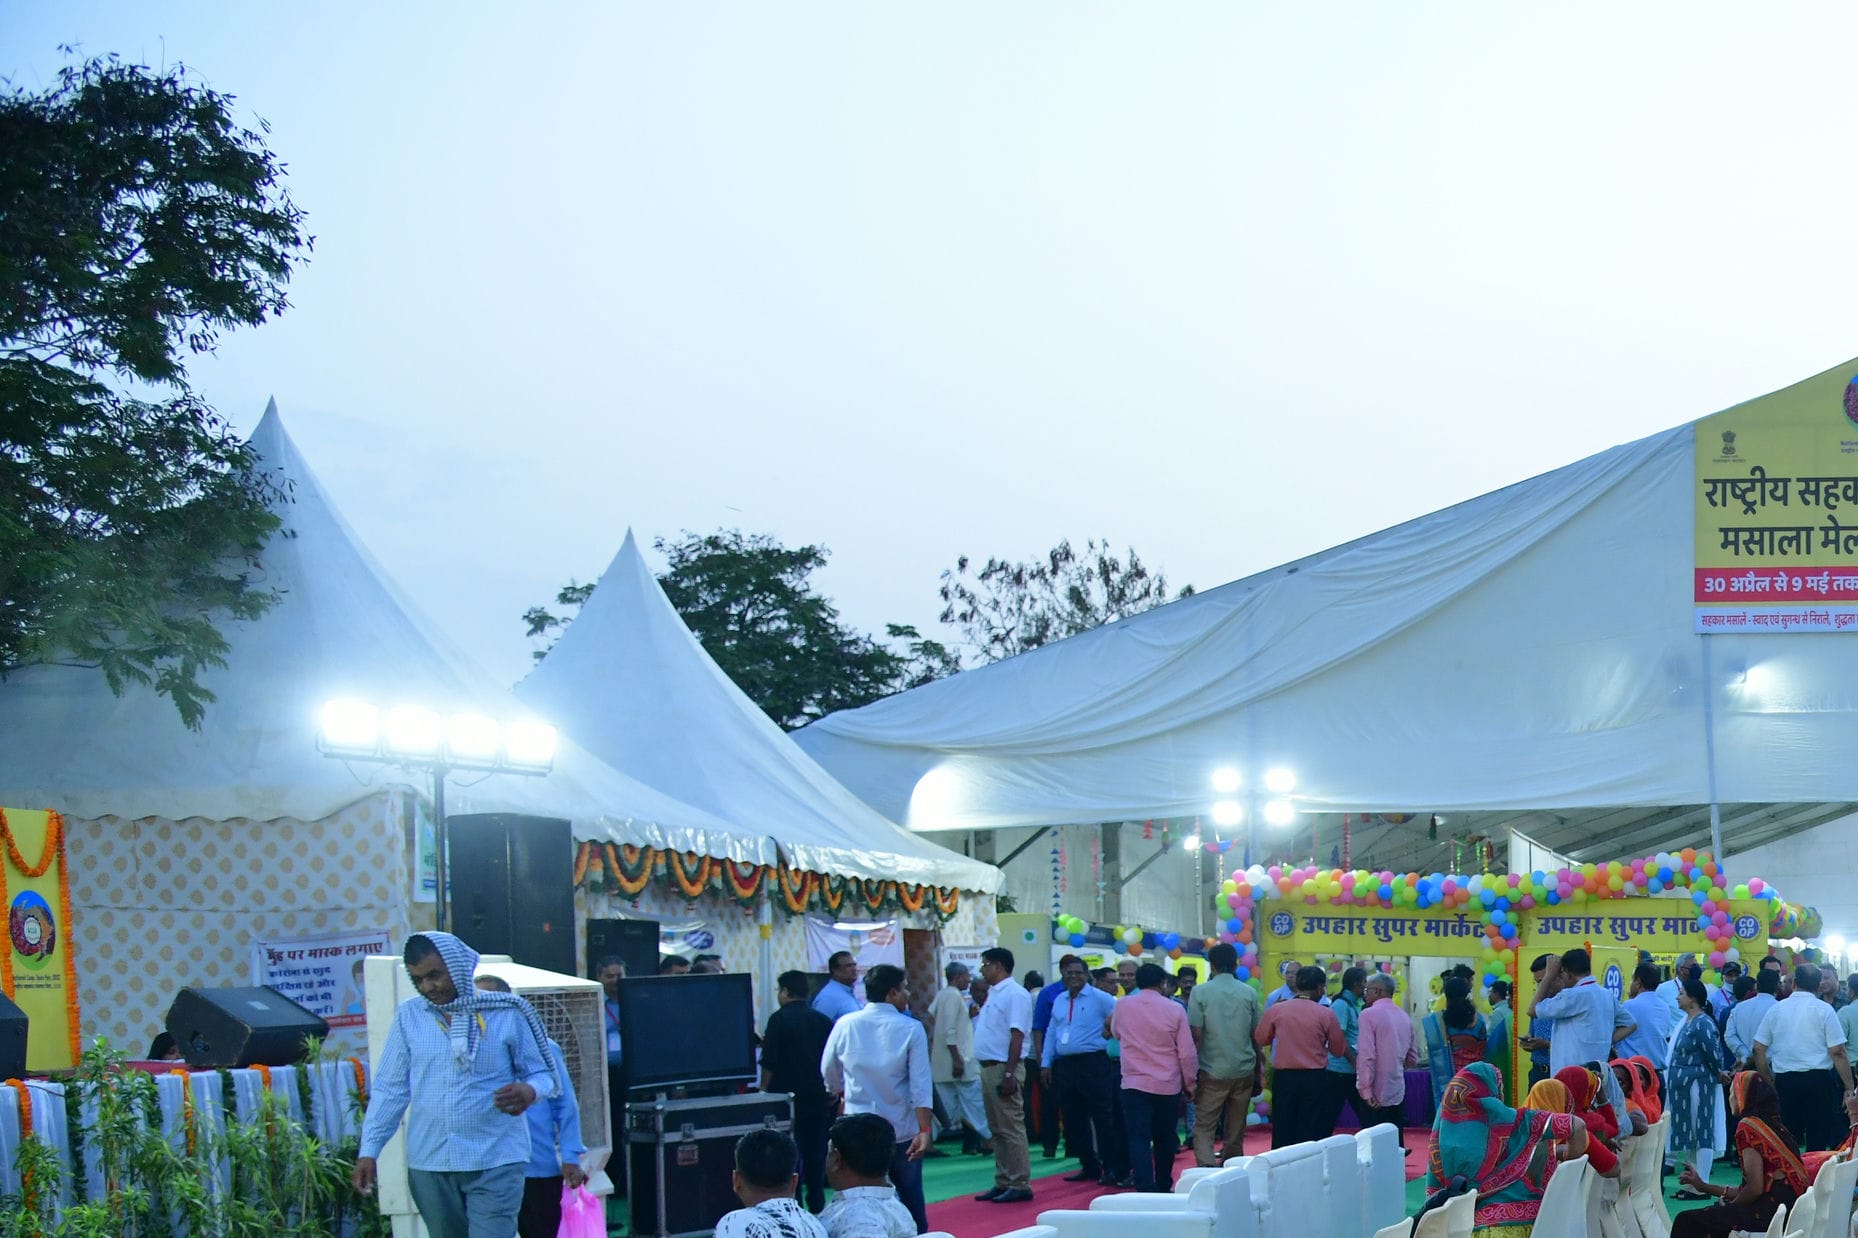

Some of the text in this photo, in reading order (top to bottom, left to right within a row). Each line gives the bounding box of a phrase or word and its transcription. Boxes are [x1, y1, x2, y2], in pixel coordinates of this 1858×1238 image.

[1703, 465, 1792, 515] राष्ट्रीय
[1718, 526, 1814, 556] मसाला
[1704, 577, 1726, 593] 30
[1730, 571, 1772, 593] अप्रैल
[1773, 571, 1788, 592] से
[1792, 576, 1802, 592] 9
[1806, 571, 1830, 594] मई
[1701, 614, 1725, 627] सहकार
[1752, 614, 1768, 626] स्वाद
[1770, 612, 1780, 625] एवं
[1802, 612, 1808, 624] से
[1274, 915, 1290, 925] CO
[1738, 918, 1754, 928] CO
[1274, 924, 1289, 934] OP
[1302, 916, 1368, 936] उपहार
[1372, 918, 1420, 942] सुपर
[1536, 916, 1604, 935] उपहार
[1608, 916, 1657, 942] सुपर
[1738, 927, 1754, 936] OP
[288, 948, 304, 960] पर
[308, 946, 342, 958] मास्क
[1607, 970, 1620, 986] CO
